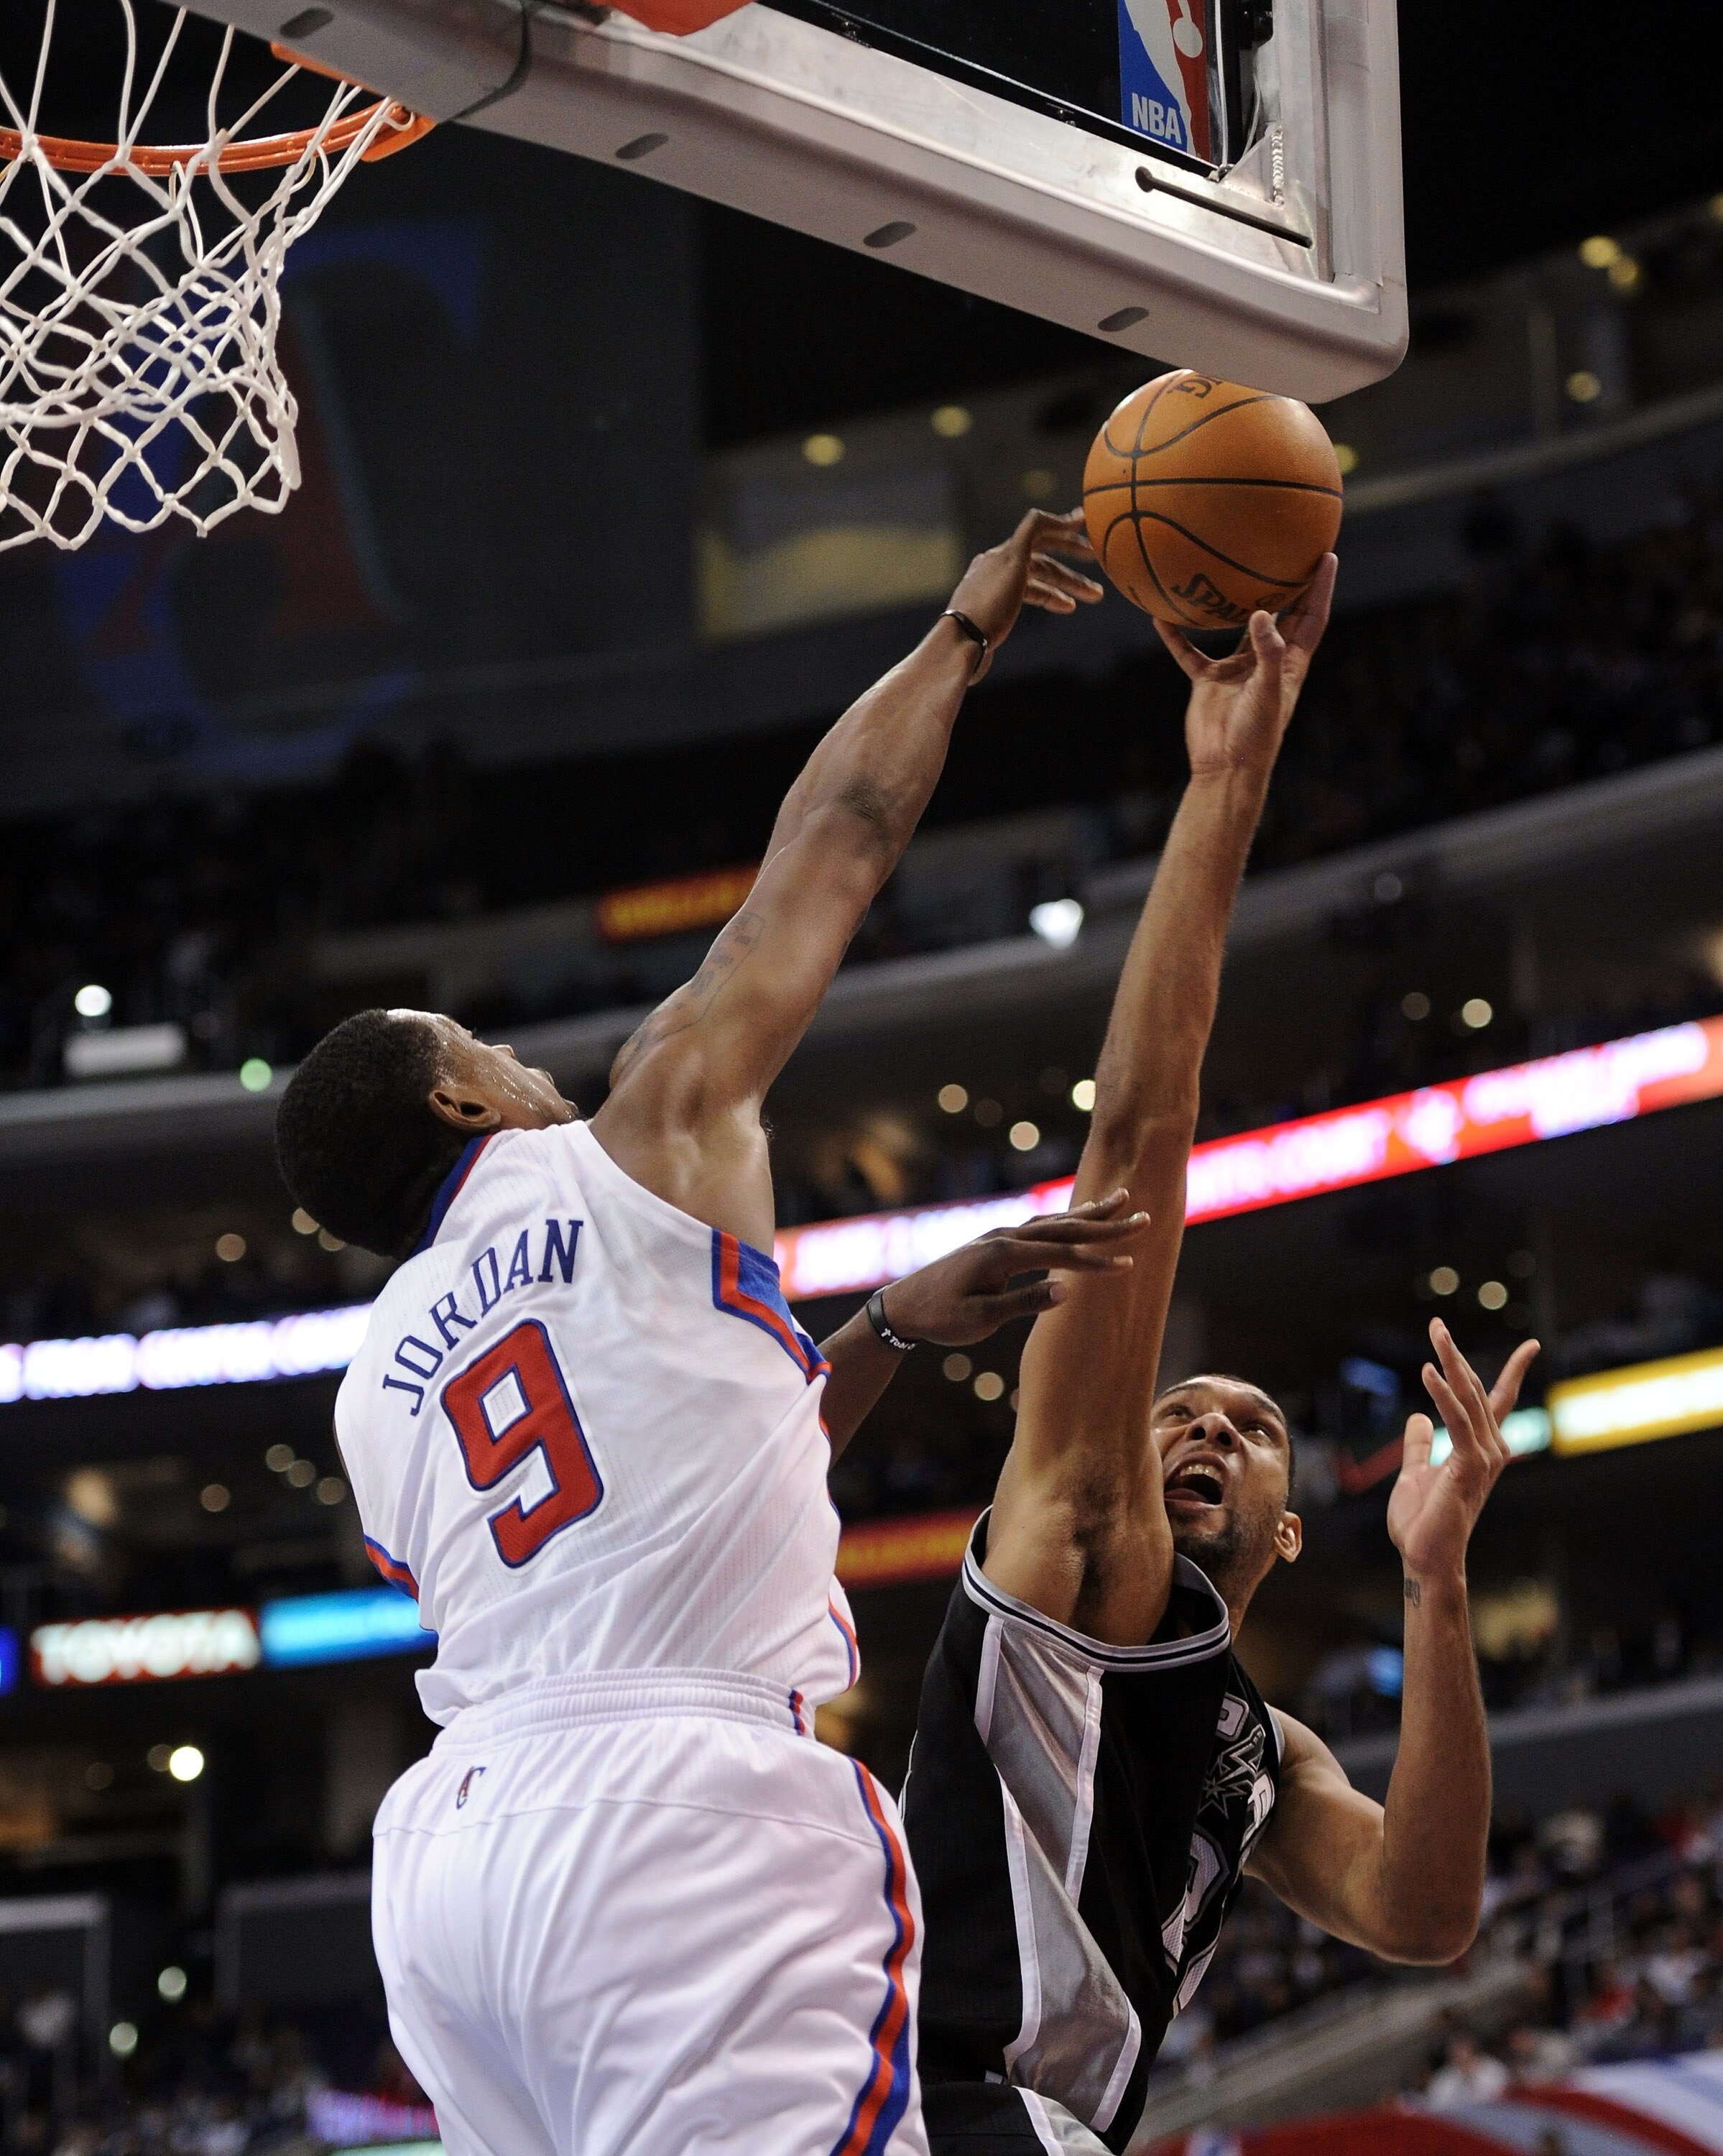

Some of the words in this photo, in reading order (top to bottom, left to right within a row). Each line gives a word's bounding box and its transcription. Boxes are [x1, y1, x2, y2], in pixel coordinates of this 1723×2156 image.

[1132, 92, 1182, 144] NBA
[382, 1219, 583, 1417] JORDAN
[440, 1318, 604, 1569] 9
